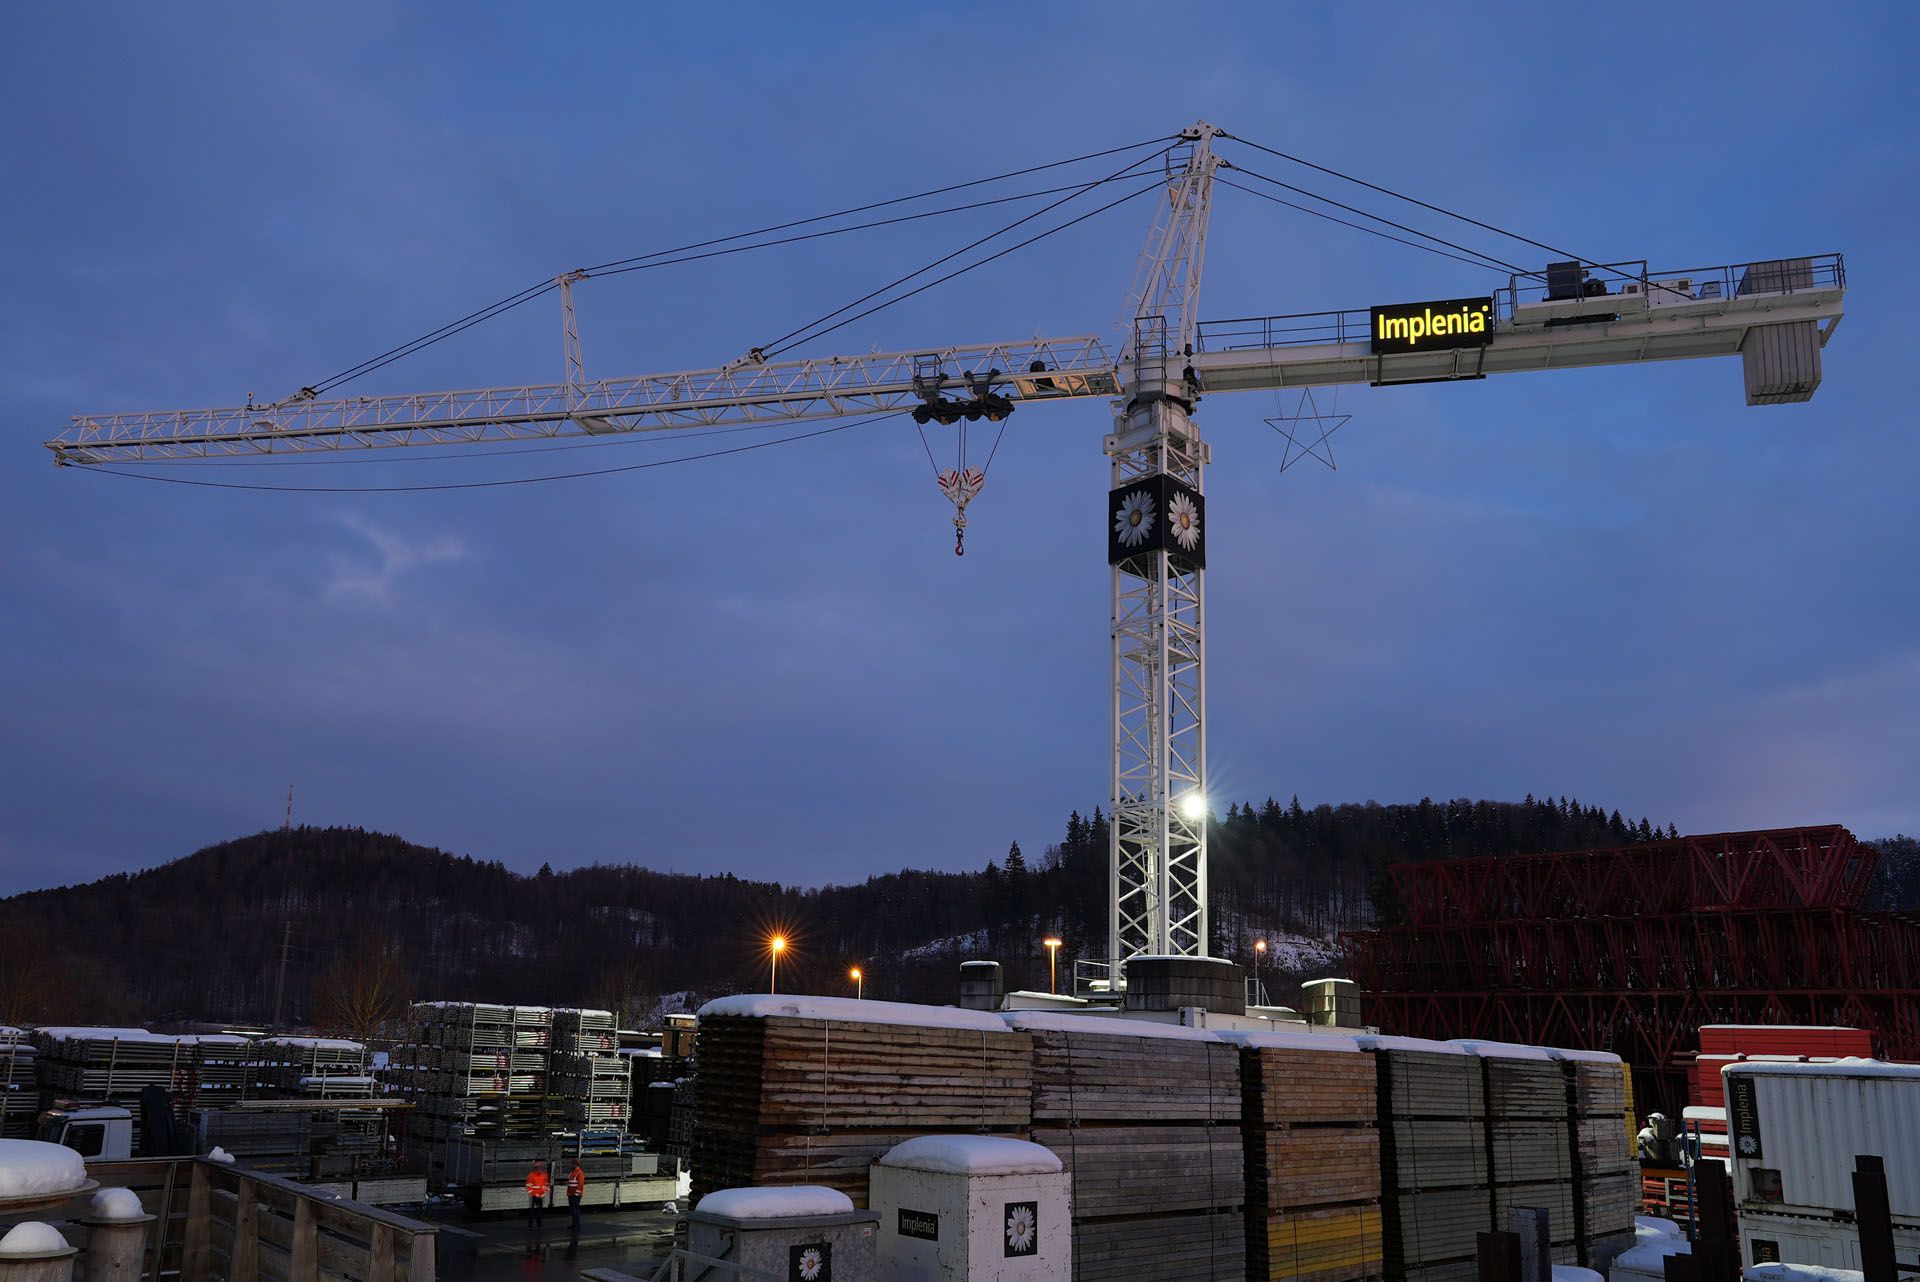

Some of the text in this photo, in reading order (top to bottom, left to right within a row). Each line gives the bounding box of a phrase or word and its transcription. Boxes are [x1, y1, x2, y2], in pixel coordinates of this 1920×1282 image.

[1378, 305, 1489, 345] Implenia
[1736, 1083, 1754, 1134] Implenia
[901, 1215, 936, 1234] Implenia
